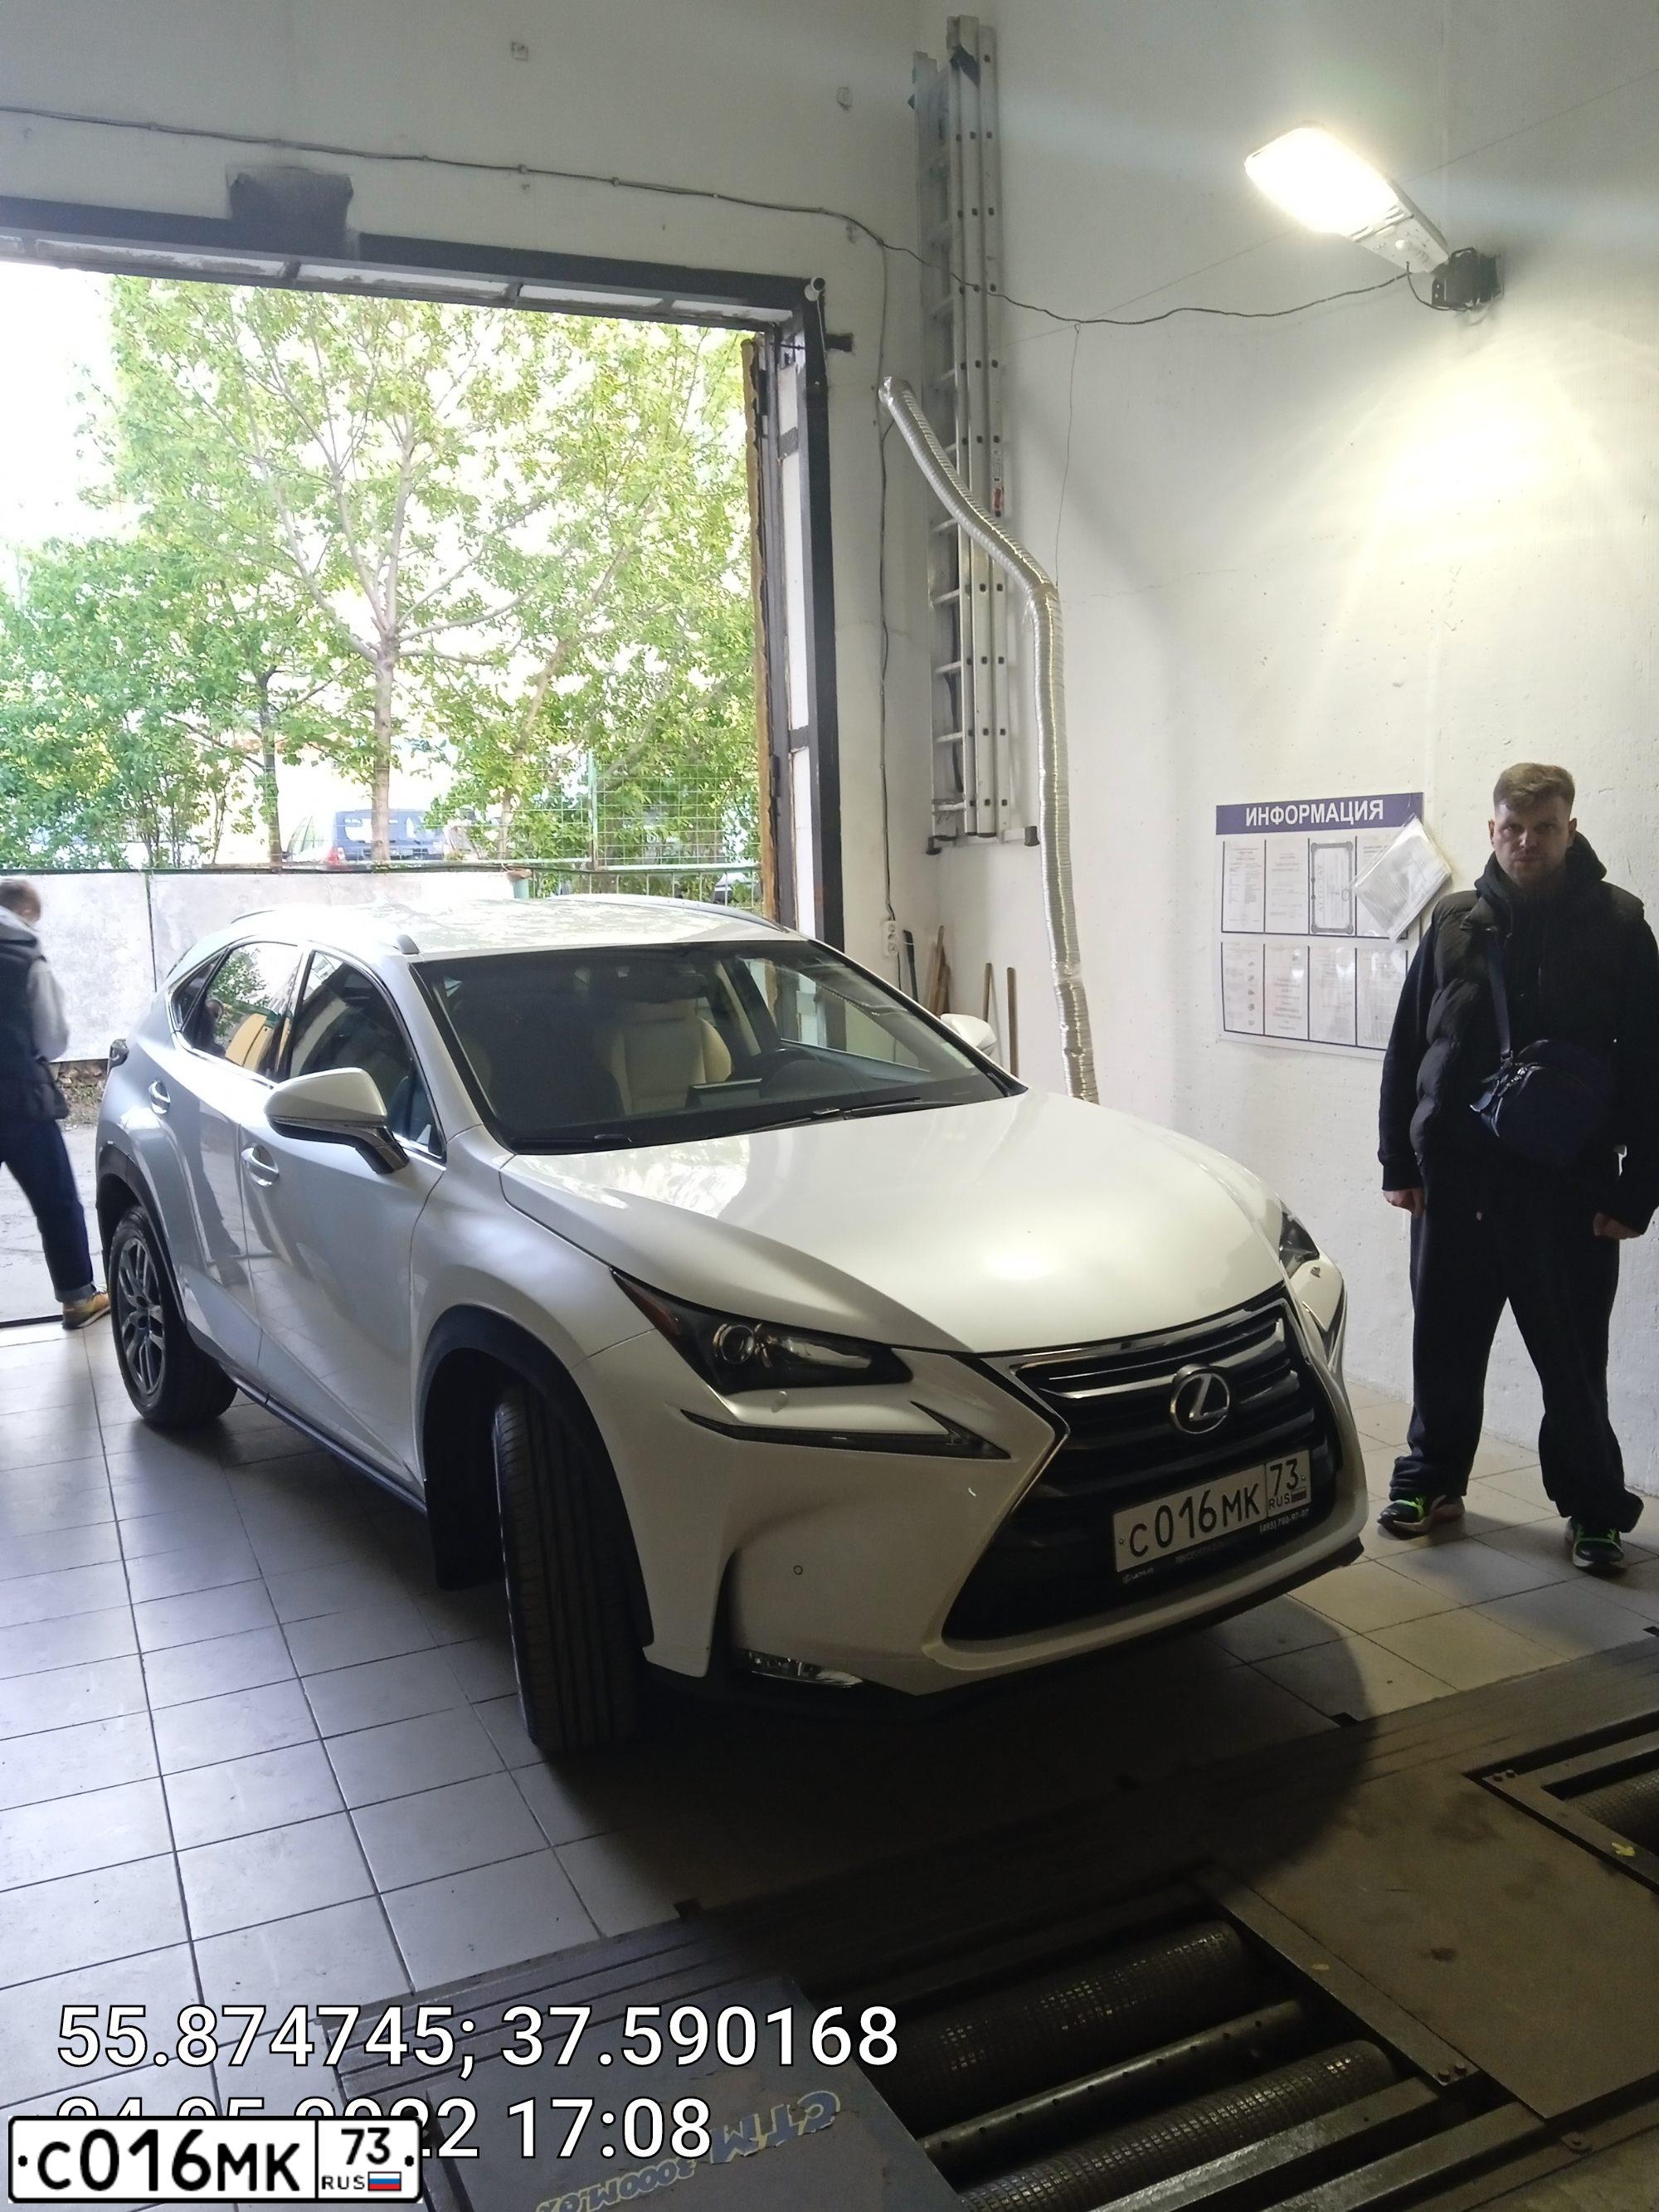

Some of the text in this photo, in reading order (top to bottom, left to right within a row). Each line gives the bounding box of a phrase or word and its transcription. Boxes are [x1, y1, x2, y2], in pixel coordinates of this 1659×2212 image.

[1246, 800, 1384, 826] ИНФОРМАЦИЯ
[1129, 1484, 1260, 1557] С016МК
[1270, 1458, 1298, 1497] 73
[1268, 1493, 1290, 1508] RUS
